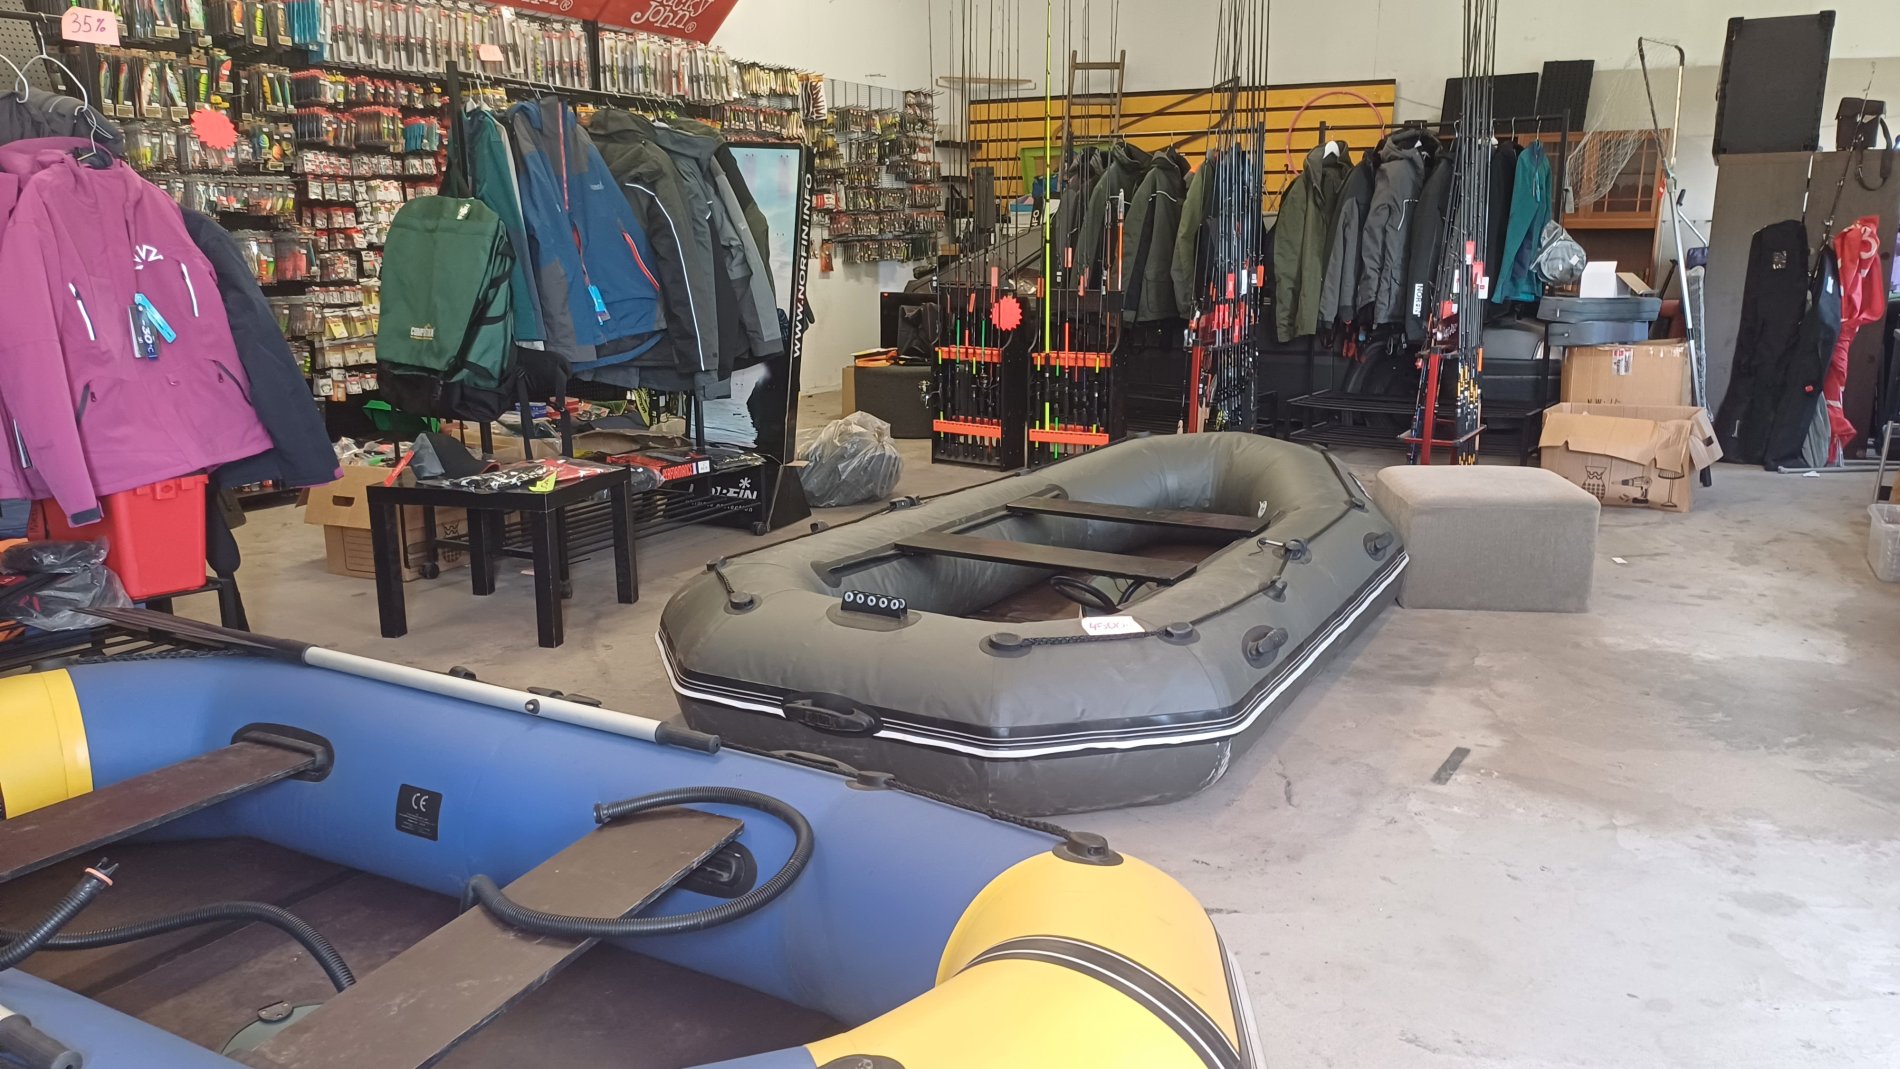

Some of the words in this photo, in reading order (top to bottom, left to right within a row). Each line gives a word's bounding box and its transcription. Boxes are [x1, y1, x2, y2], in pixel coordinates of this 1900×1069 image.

[70, 12, 106, 33] 35%
[793, 173, 812, 358] WWW.NORFIN.INFO
[411, 793, 429, 812] CE
